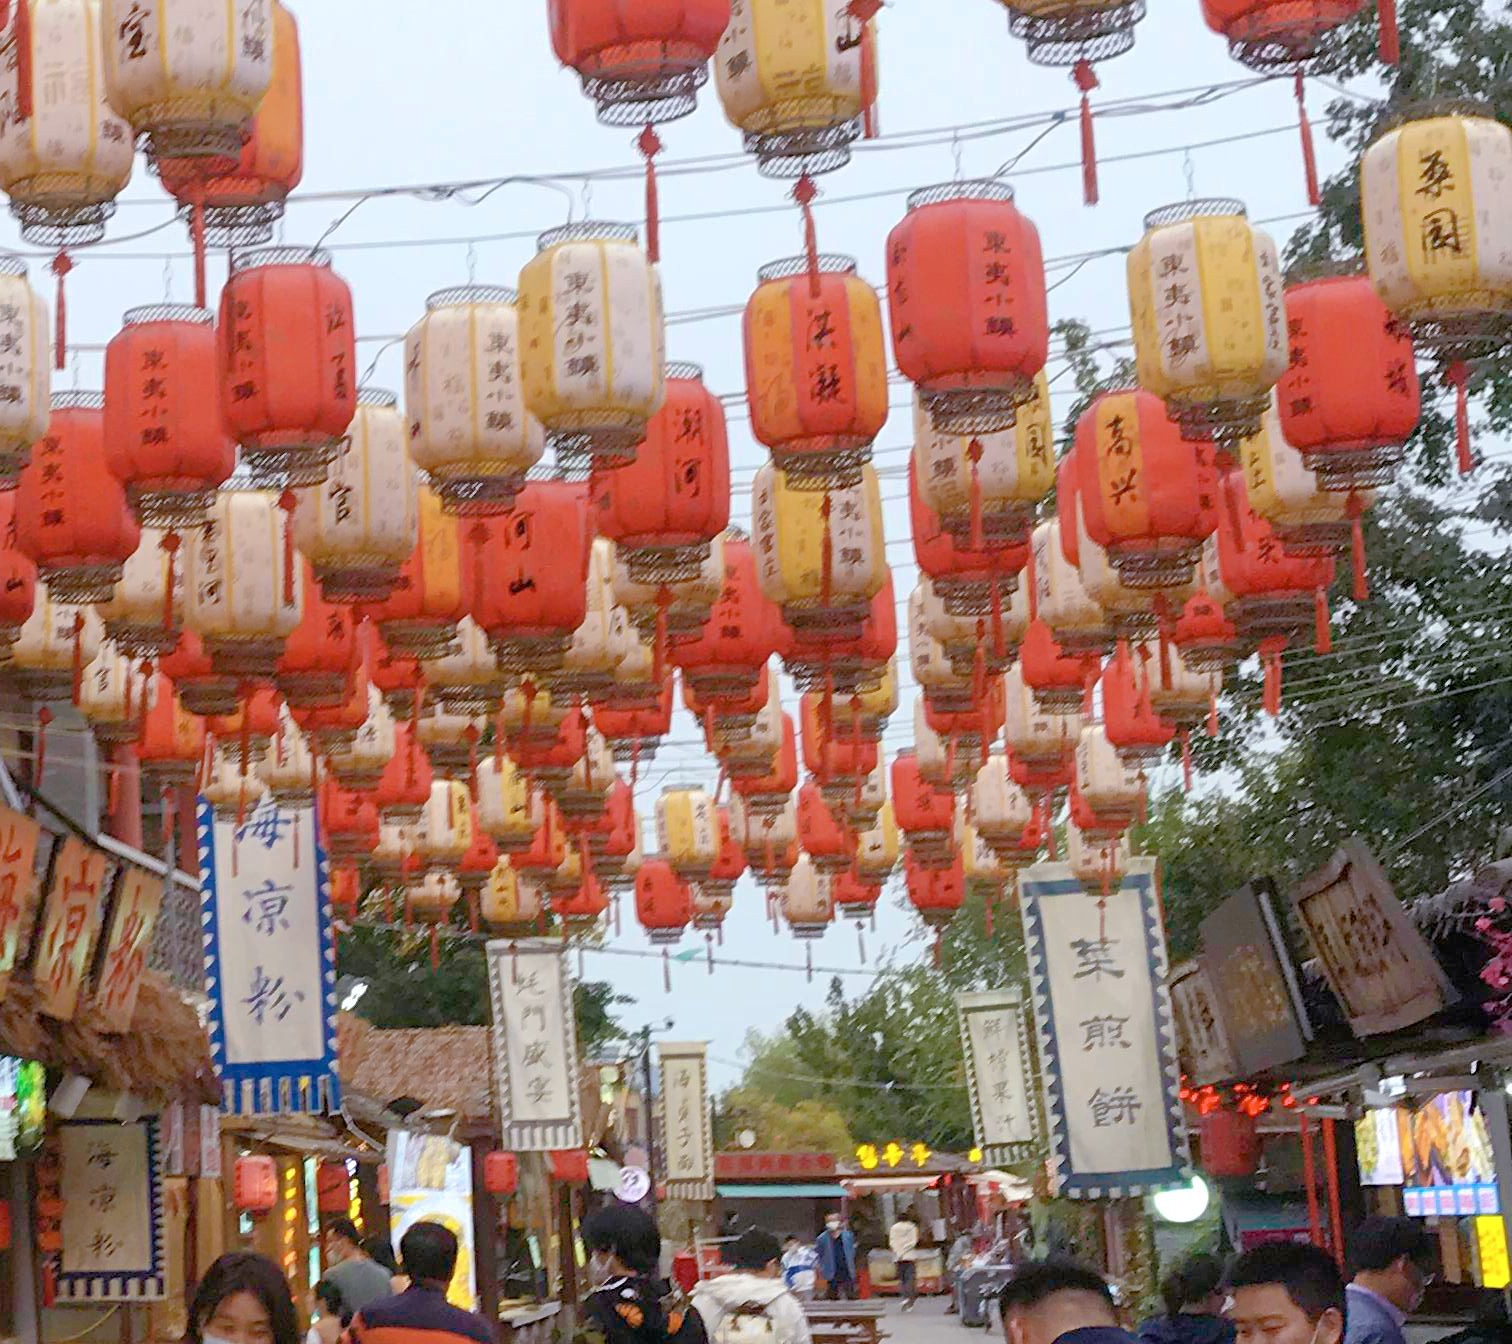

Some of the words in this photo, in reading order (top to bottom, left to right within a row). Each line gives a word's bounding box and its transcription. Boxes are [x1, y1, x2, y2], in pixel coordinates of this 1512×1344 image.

[563, 271, 599, 380] 東夷小鎮
[981, 229, 1021, 340] 東夷小鎮
[140, 350, 172, 446] 東夷小鎮
[484, 331, 514, 433] 東夷小鎮
[40, 435, 65, 528] 東夷小鎮
[929, 436, 959, 480] 小鎮
[837, 496, 867, 568] 夷小鎮
[234, 794, 306, 1028] 海凉粉
